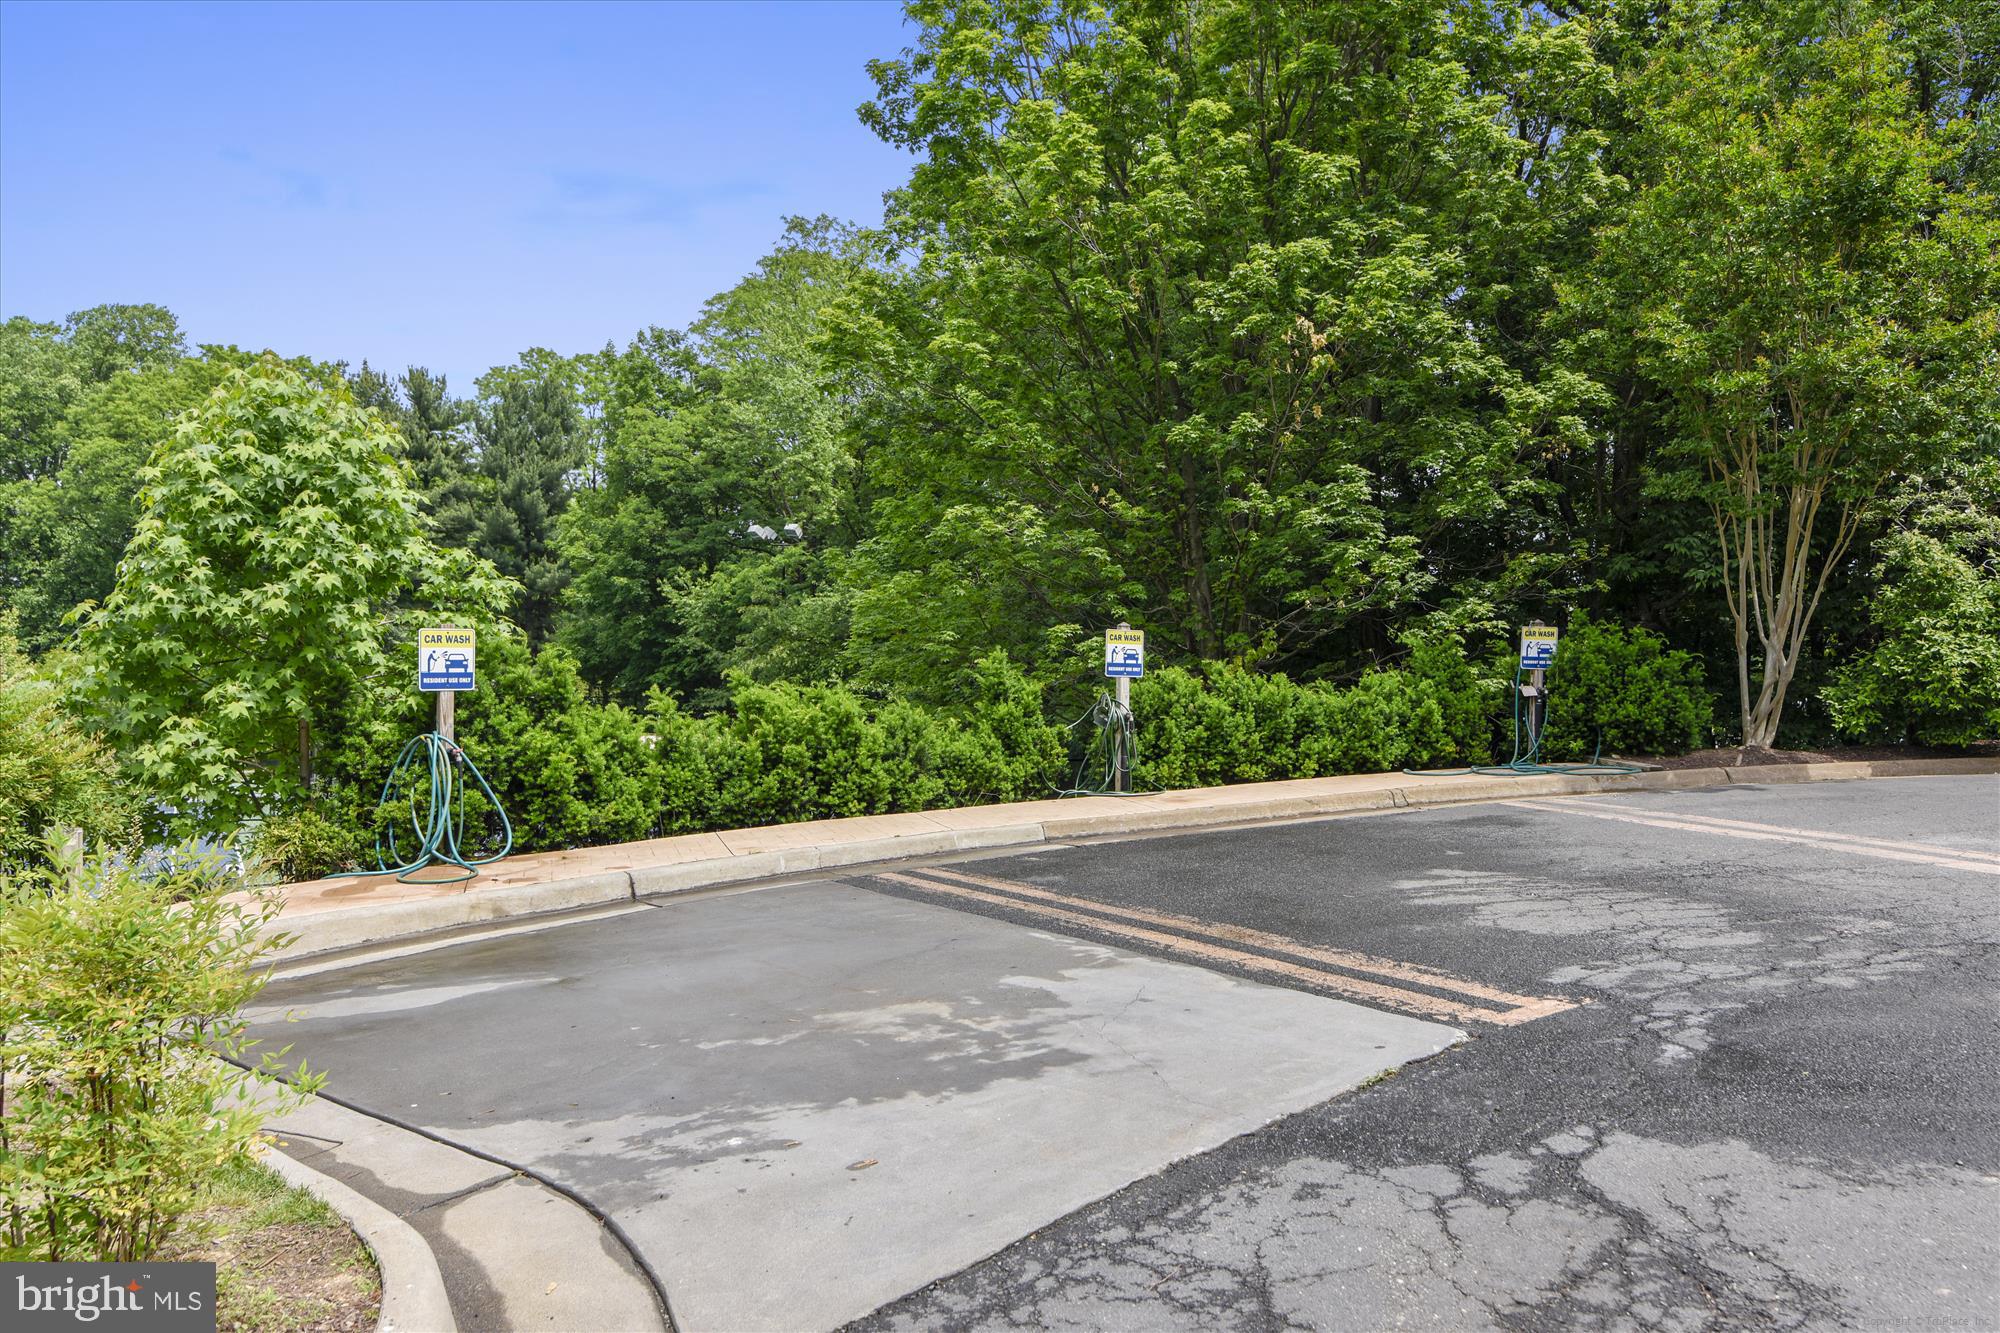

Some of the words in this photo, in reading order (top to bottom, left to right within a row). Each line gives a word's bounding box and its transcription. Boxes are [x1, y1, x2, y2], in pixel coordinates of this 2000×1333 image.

[424, 634, 443, 644] CAR
[445, 634, 471, 644] WASH
[1124, 634, 1141, 642] WASH
